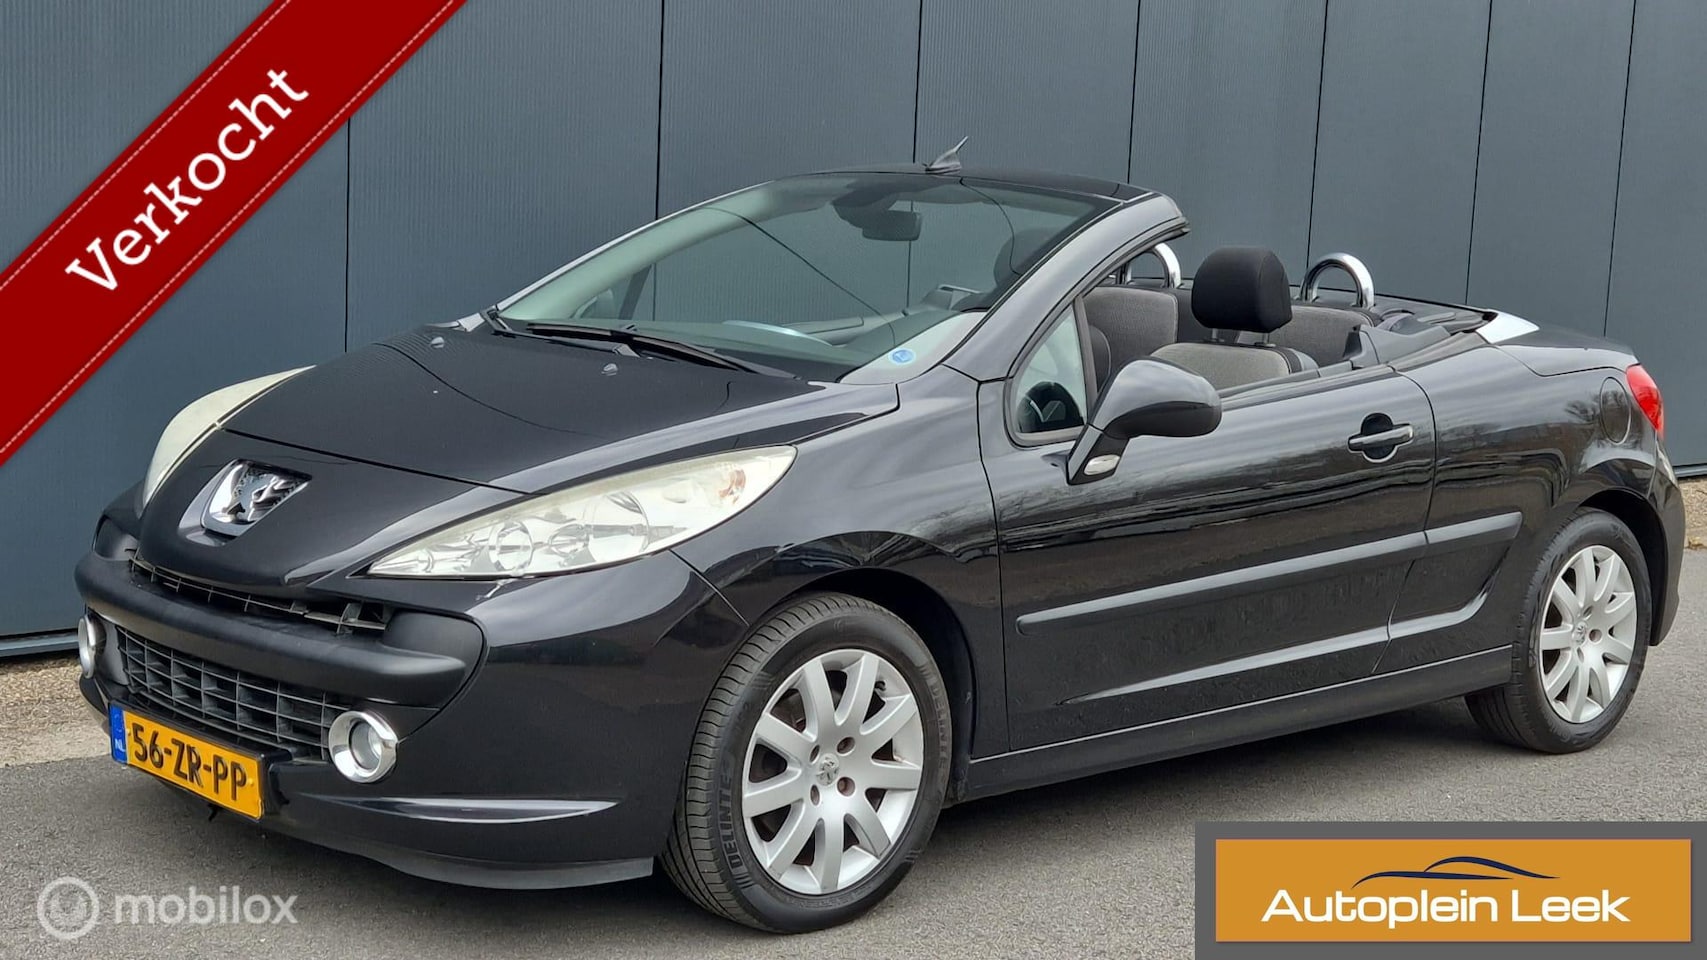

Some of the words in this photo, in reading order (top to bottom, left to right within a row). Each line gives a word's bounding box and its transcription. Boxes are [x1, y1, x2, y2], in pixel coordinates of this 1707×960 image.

[114, 738, 126, 752] NL
[132, 722, 247, 801] 56-ZR-PP
[718, 770, 746, 873] DELINTE
